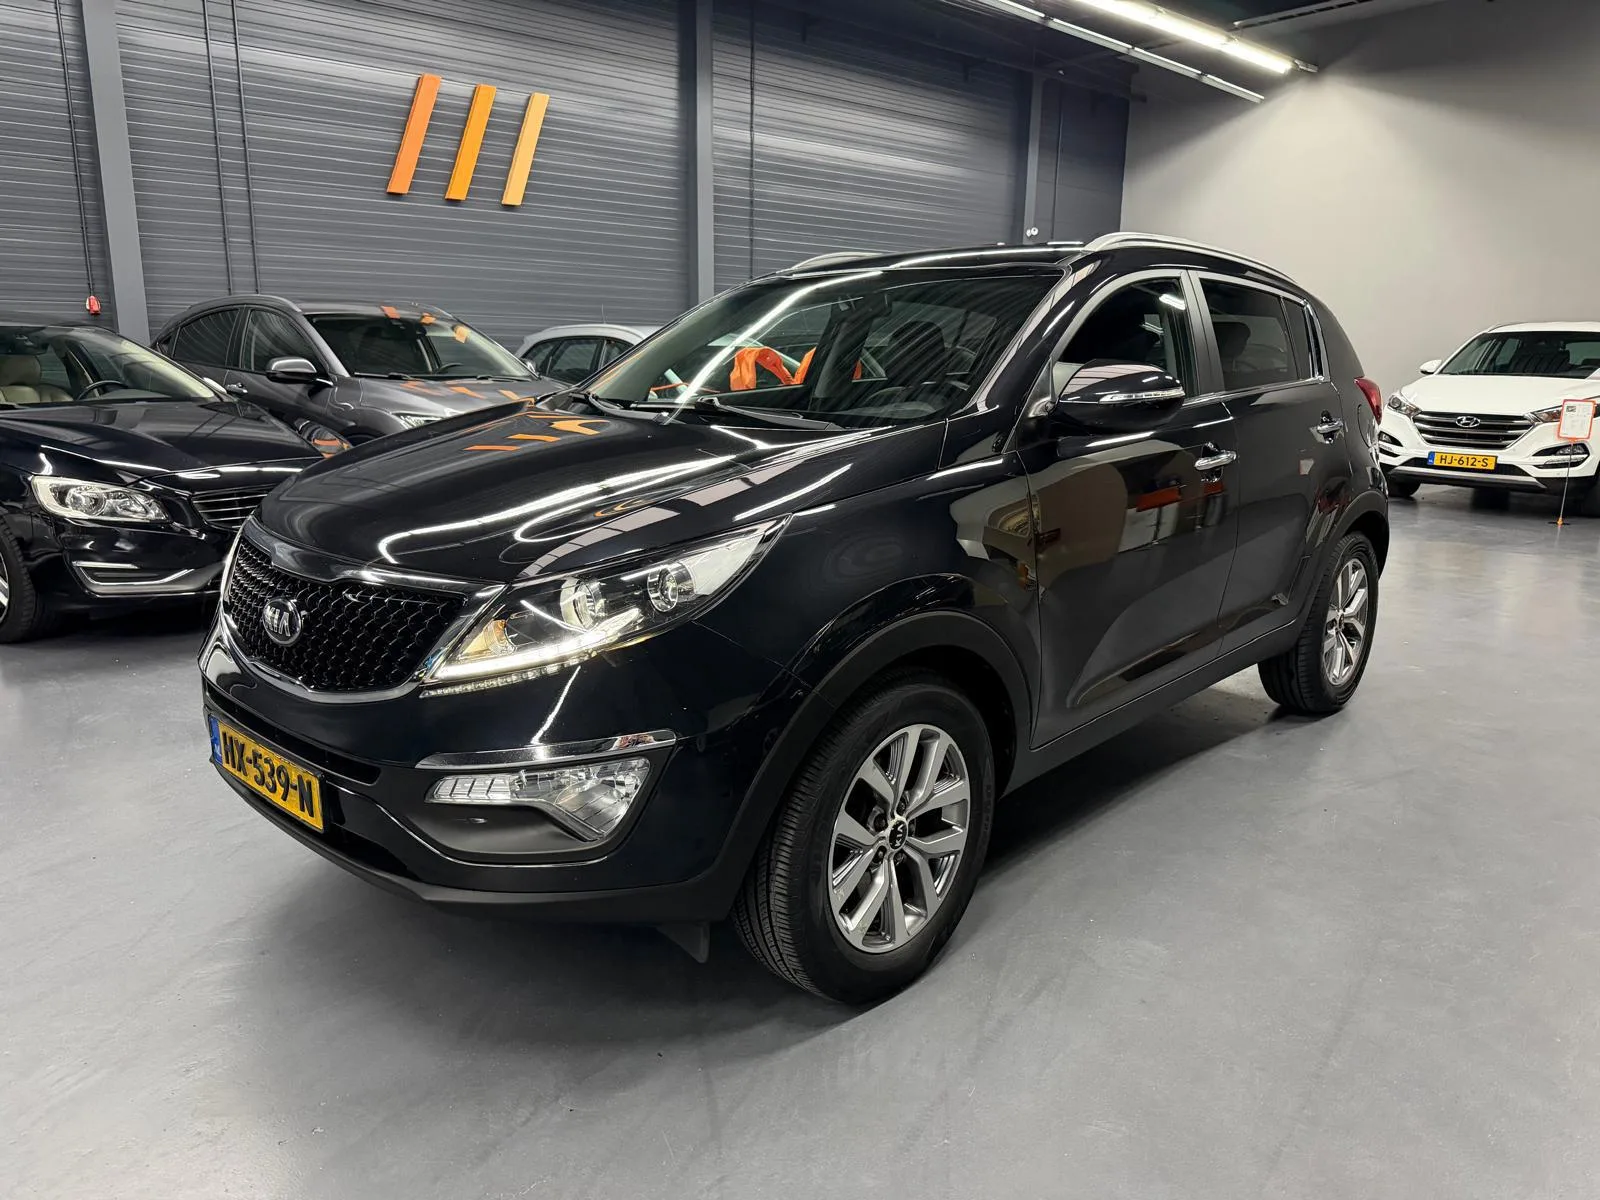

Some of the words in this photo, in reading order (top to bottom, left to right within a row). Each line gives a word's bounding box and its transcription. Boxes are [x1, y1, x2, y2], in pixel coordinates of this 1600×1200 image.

[1439, 455, 1489, 467] HJ-612-S
[263, 605, 291, 637] KIA
[222, 731, 315, 818] HX-539-N
[894, 823, 904, 847] KIA
